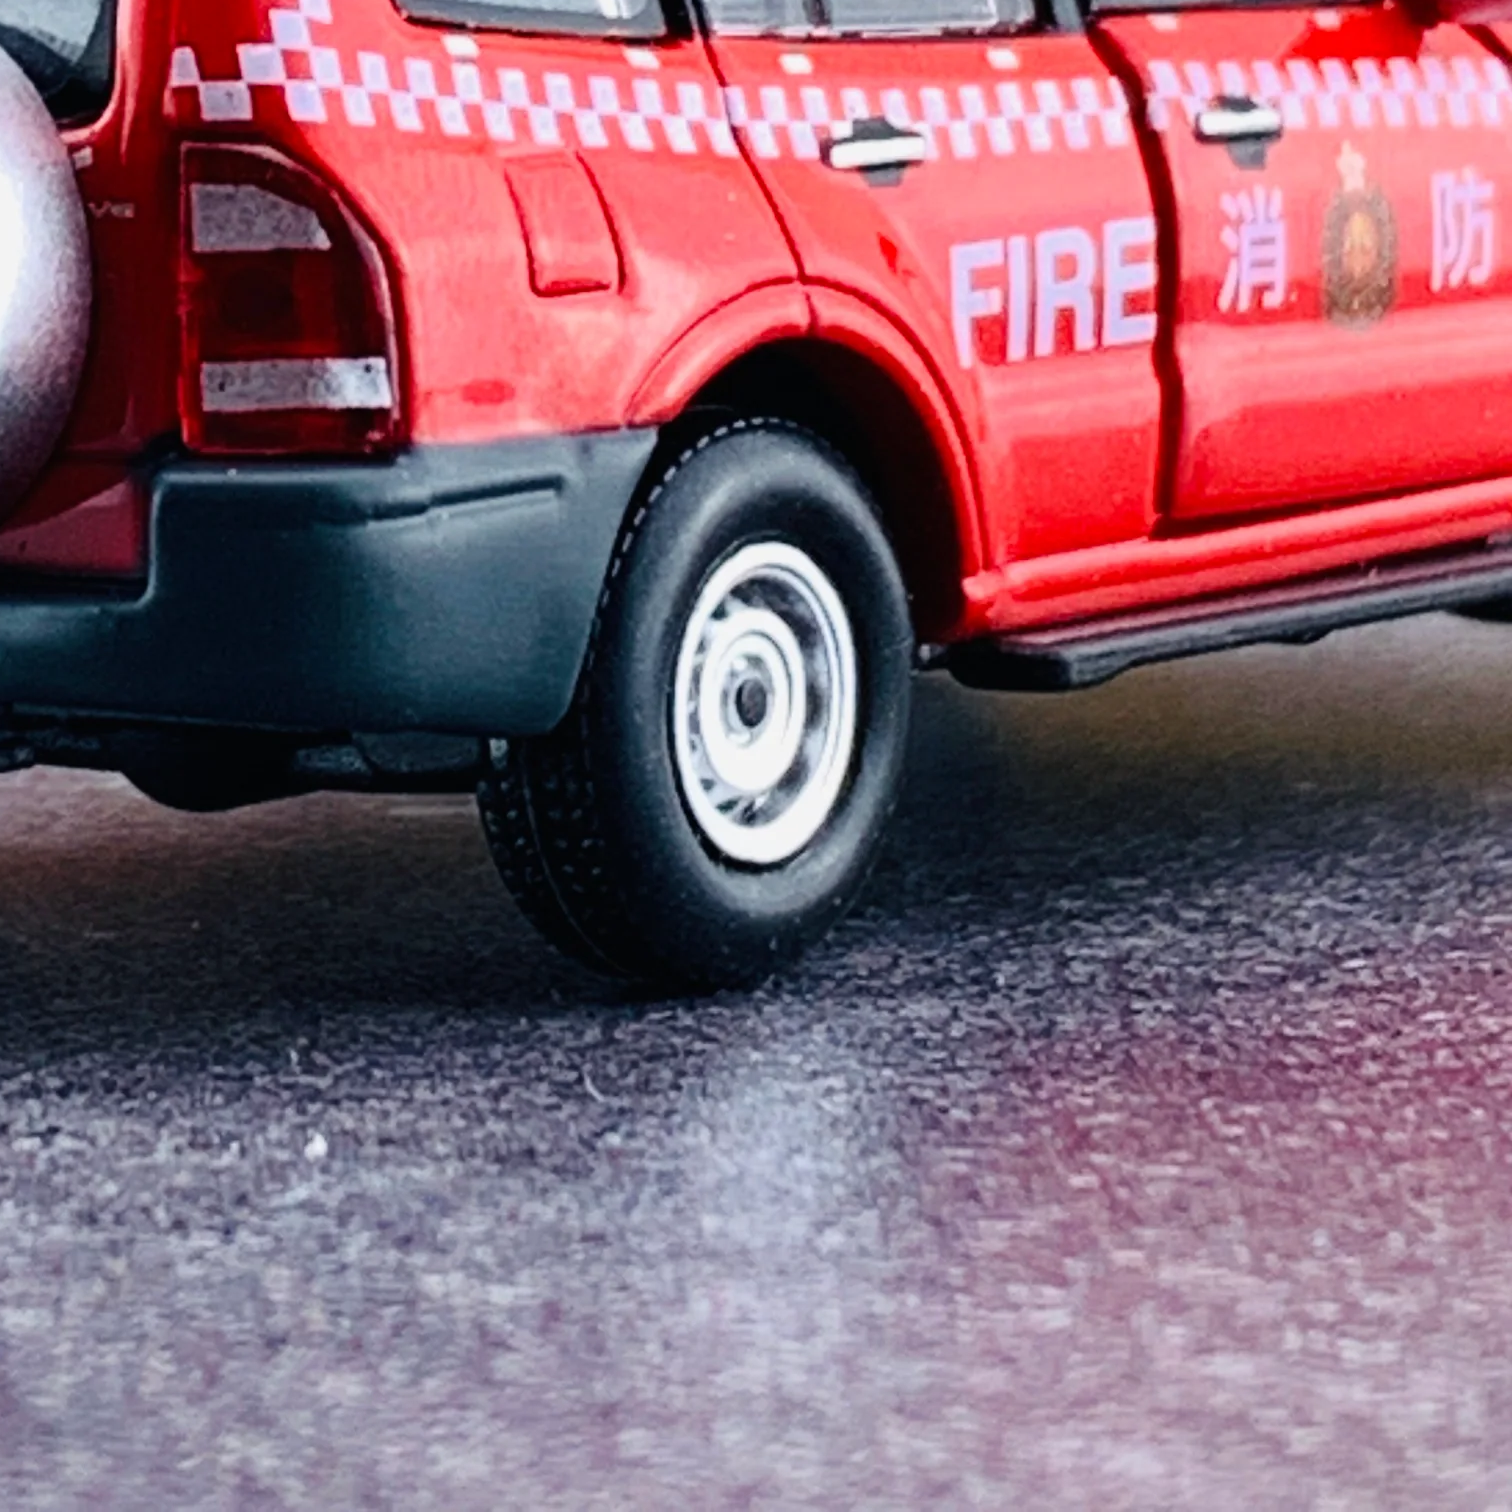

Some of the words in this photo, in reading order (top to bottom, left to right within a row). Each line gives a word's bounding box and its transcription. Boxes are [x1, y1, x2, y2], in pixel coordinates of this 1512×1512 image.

[949, 215, 1158, 370] FIRE
[1218, 185, 1287, 313] 消
[1430, 163, 1495, 292] 防
